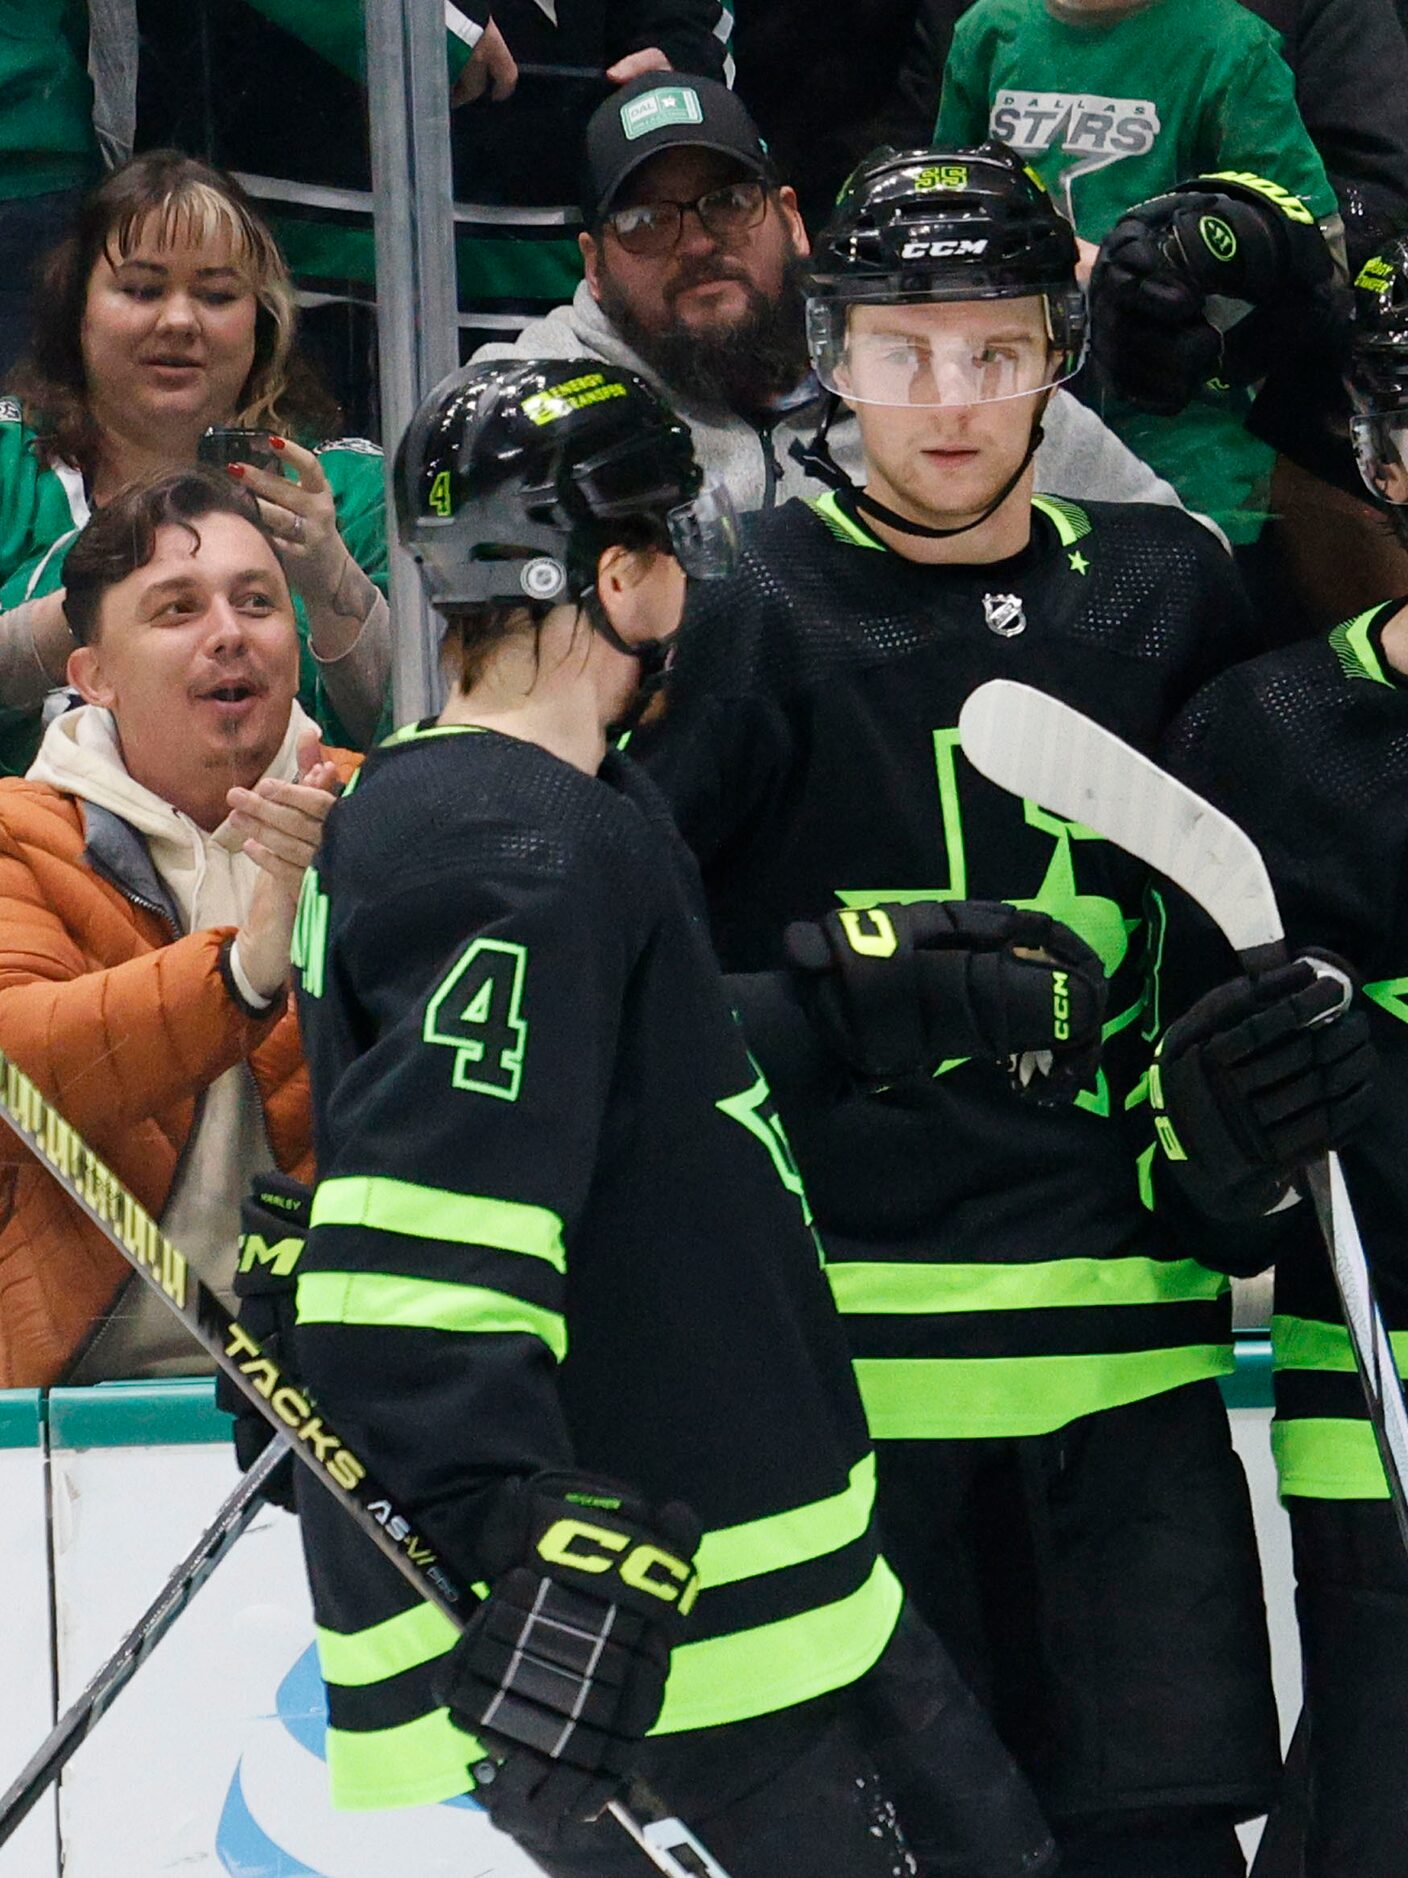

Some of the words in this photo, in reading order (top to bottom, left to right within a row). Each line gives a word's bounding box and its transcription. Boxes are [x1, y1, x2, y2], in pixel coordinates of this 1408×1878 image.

[994, 103, 1154, 151] STARS
[1003, 97, 1145, 114] DALLAS
[915, 166, 967, 191] 55
[902, 239, 988, 259] CCM
[429, 471, 451, 516] 4
[424, 937, 527, 1102] 4
[1052, 971, 1069, 1041] CCM
[225, 1322, 367, 1490] TACKS
